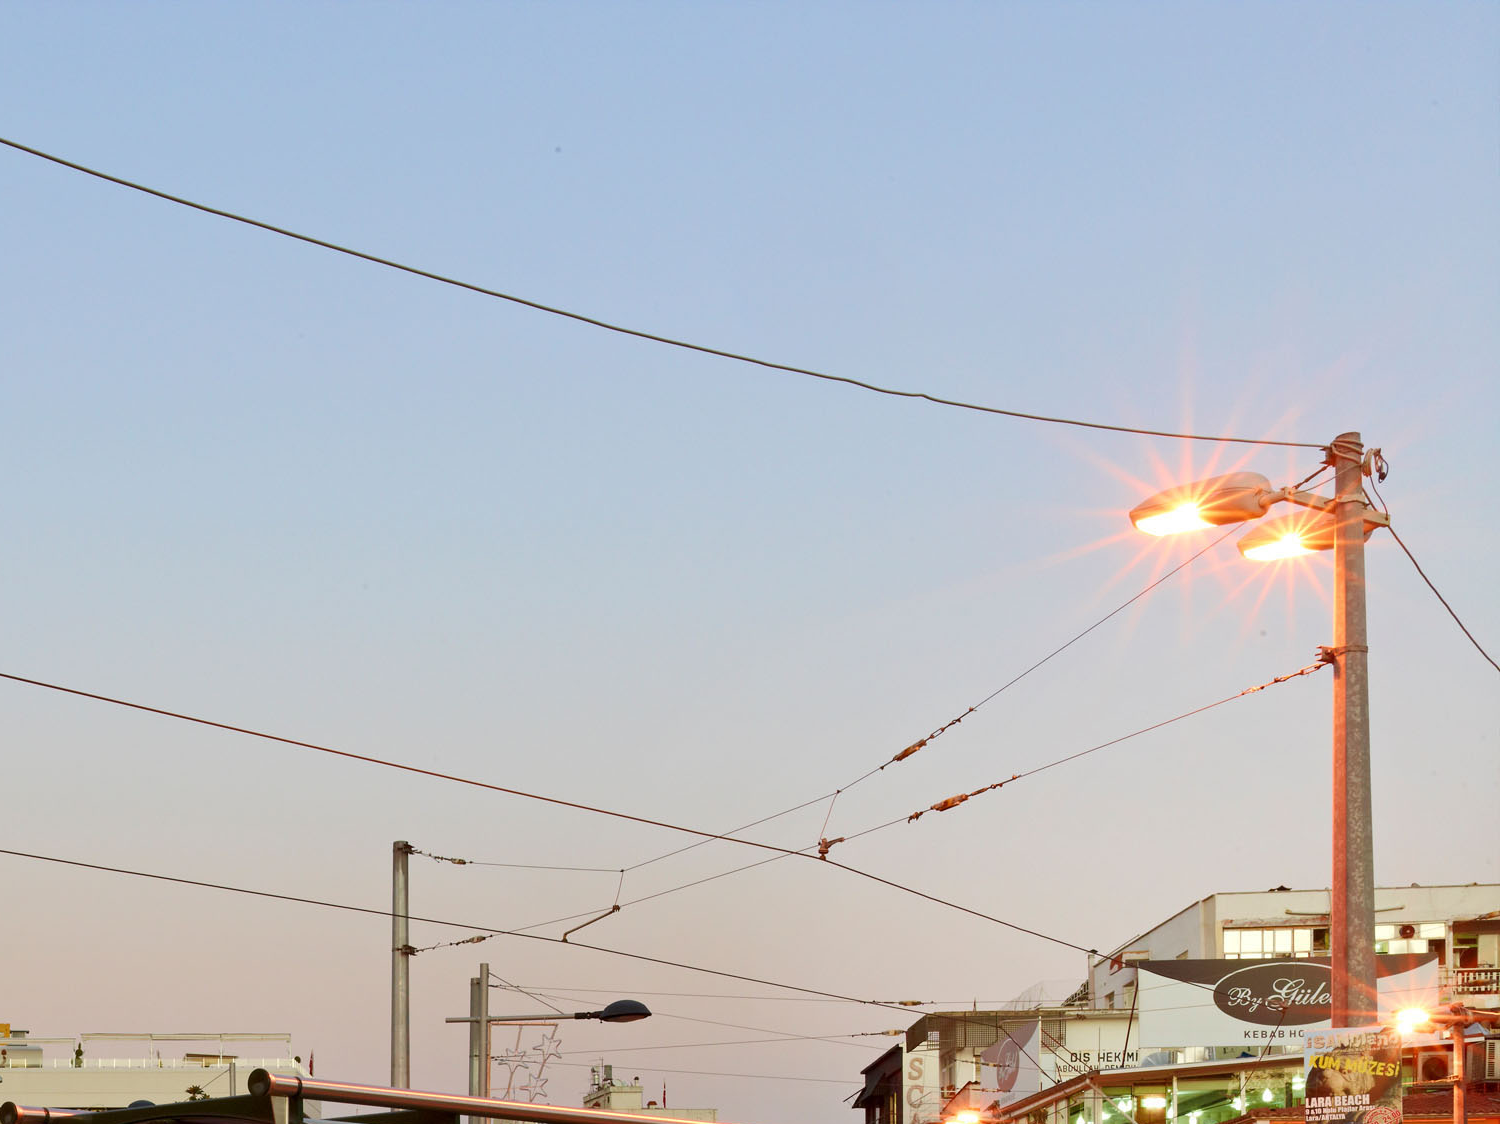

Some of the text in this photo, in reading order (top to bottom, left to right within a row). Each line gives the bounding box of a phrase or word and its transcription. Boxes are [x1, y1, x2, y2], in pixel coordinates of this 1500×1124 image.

[1227, 978, 1332, 1013] By Güle
[1244, 1030, 1285, 1039] KEBAB
[1308, 1056, 1400, 1077] KUM MÜZESİ
[1305, 1094, 1370, 1109] LARA BEACH
